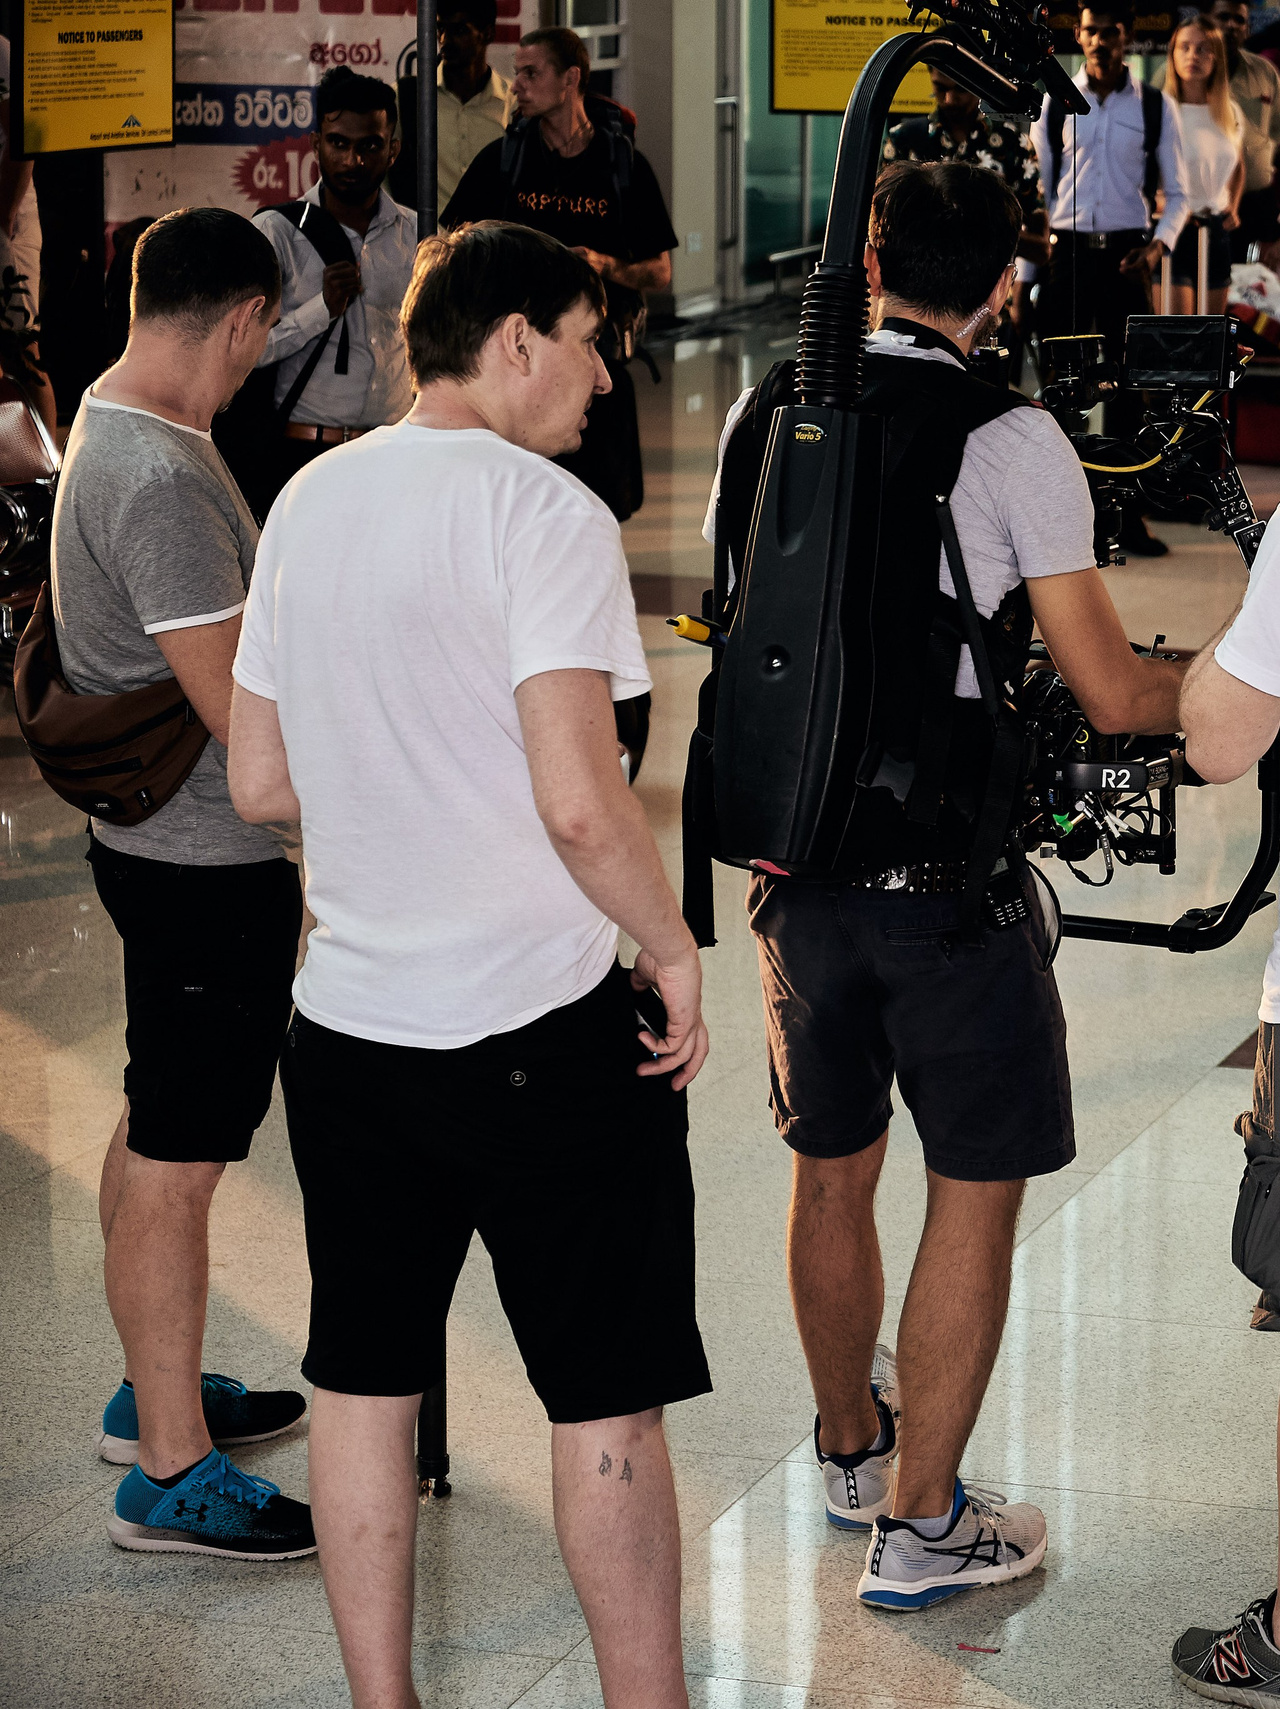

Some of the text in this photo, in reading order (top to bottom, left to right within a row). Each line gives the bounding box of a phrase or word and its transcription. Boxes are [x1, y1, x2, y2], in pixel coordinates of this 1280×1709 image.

[825, 16, 865, 26] NOTICE
[869, 17, 883, 26] TO
[58, 29, 143, 44] NOTICE TO PASSENGERS
[795, 431, 821, 441] Vario 5
[1101, 768, 1131, 789] R2
